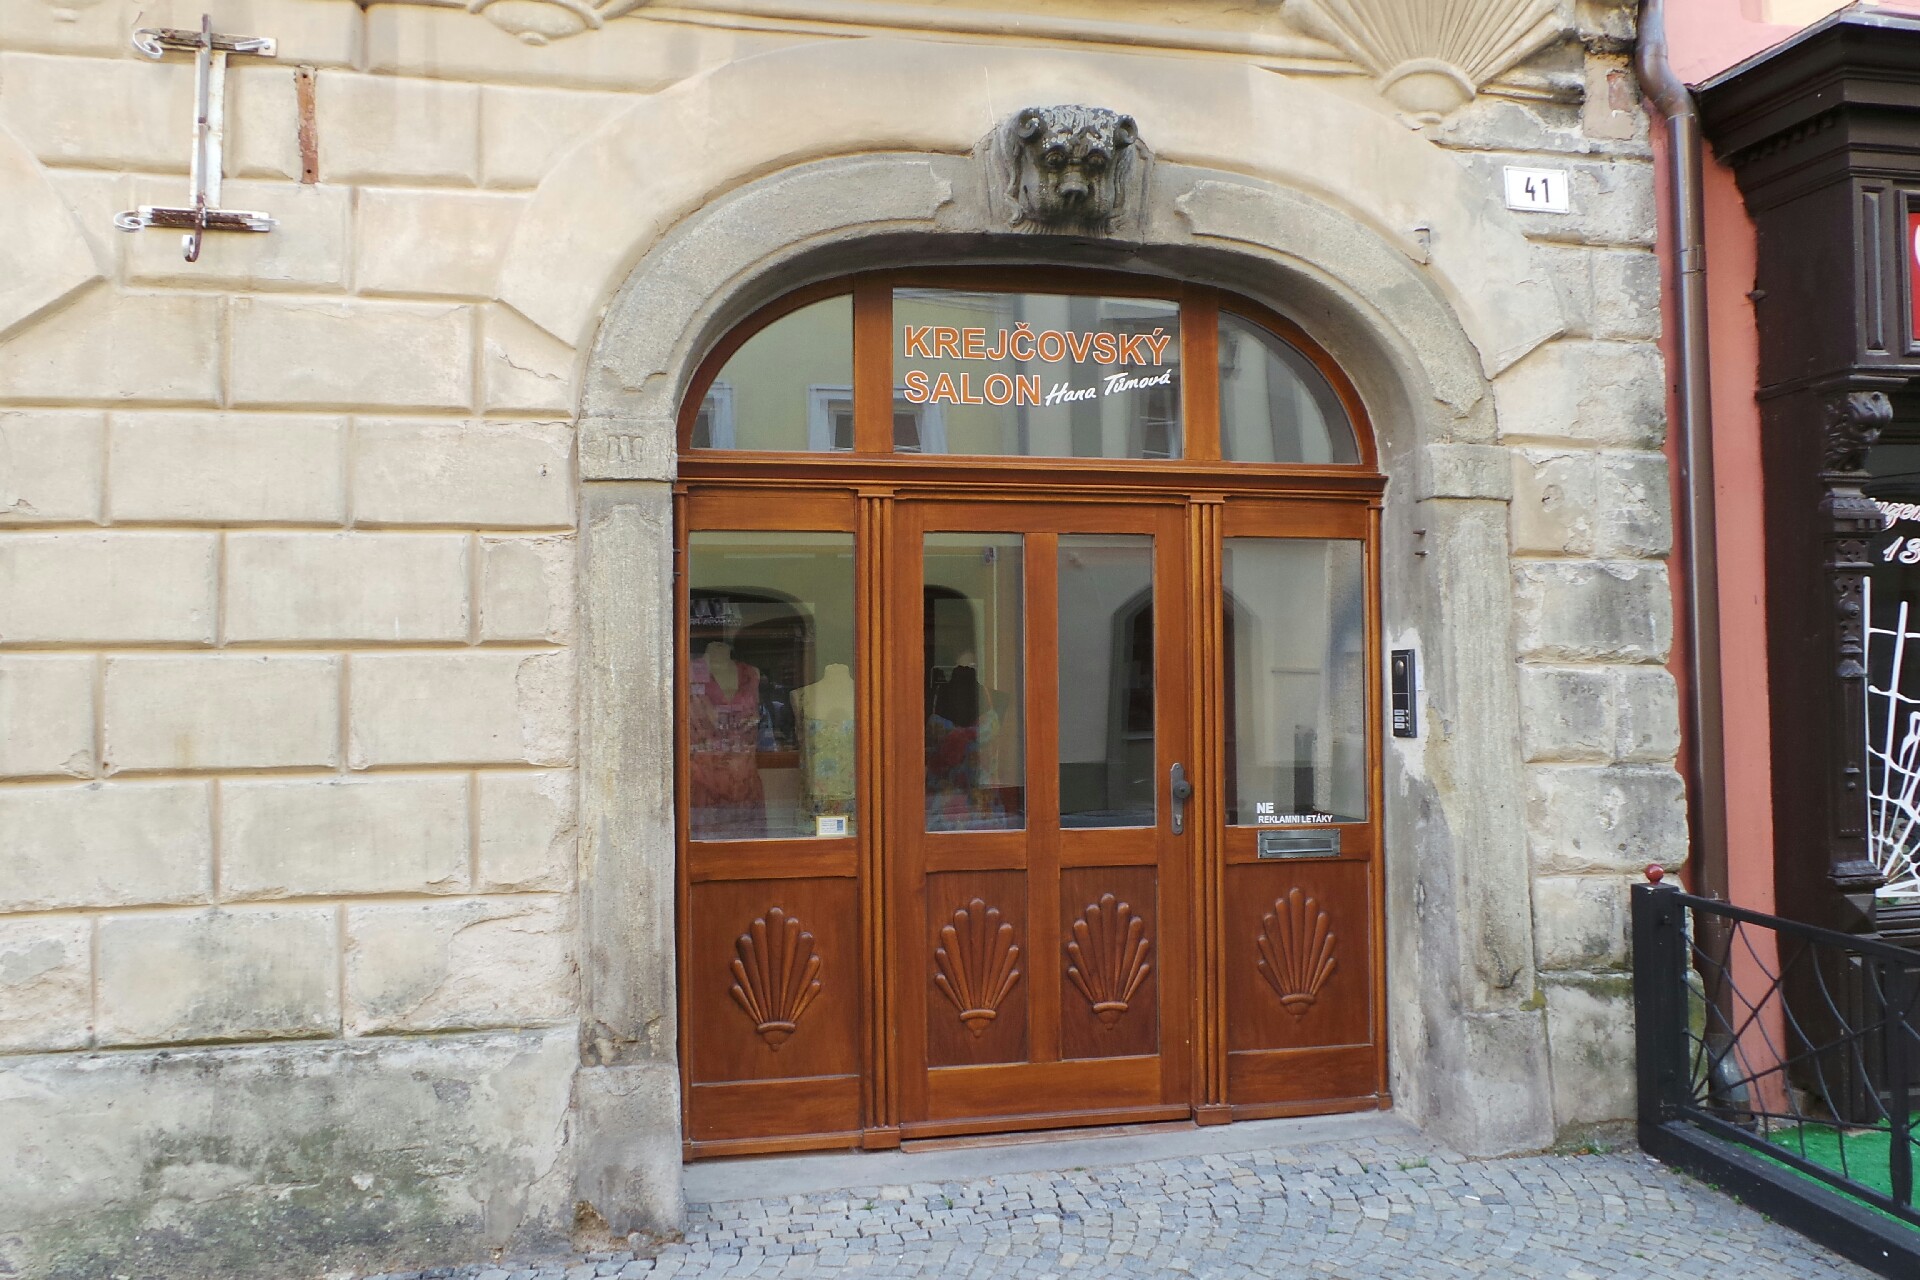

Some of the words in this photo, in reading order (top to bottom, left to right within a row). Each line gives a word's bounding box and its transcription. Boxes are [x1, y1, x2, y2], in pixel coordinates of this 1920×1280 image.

[1525, 177, 1550, 203] 41
[904, 322, 1171, 366] KREJČOVSKÝ
[904, 370, 1041, 406] SALON
[1045, 382, 1097, 406] Hana
[1256, 802, 1275, 814] NE
[1301, 813, 1333, 823] LETÁKY
